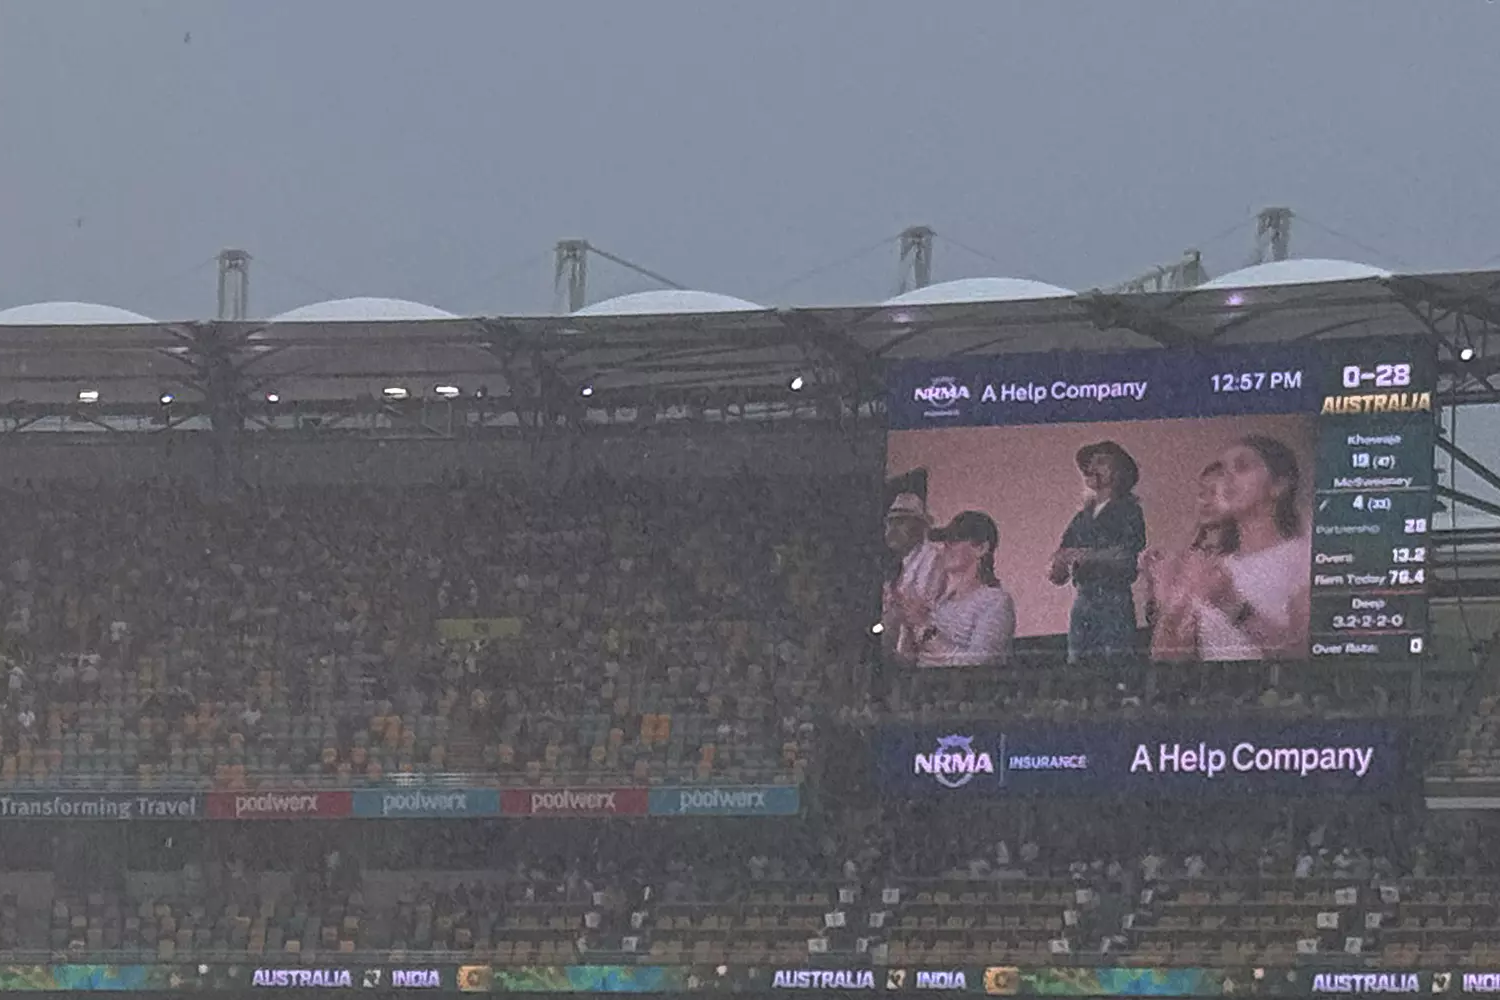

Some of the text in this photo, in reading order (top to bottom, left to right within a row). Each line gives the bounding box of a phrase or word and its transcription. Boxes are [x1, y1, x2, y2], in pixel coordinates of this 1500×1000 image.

[1211, 370, 1302, 392] 12:57 PM
[1343, 364, 1410, 388] 0-28
[914, 385, 971, 401] NRMA
[981, 381, 1147, 404] A Help Company
[1320, 392, 1431, 415] AUSTRALIA
[1352, 495, 1364, 510] 4
[1392, 547, 1426, 563] 13.2
[1409, 637, 1423, 653] 0
[914, 752, 994, 774] NRMA
[1009, 755, 1088, 770] INSURANCE
[1130, 742, 1373, 777] A Help Company
[0, 796, 196, 819] Transforming Travel
[251, 968, 352, 988] AUSTRALIA
[391, 968, 441, 988] INDIA
[771, 969, 876, 989] AUSTRALIA
[915, 969, 968, 989] INDIA
[1312, 972, 1420, 993] AUSTRALIA
